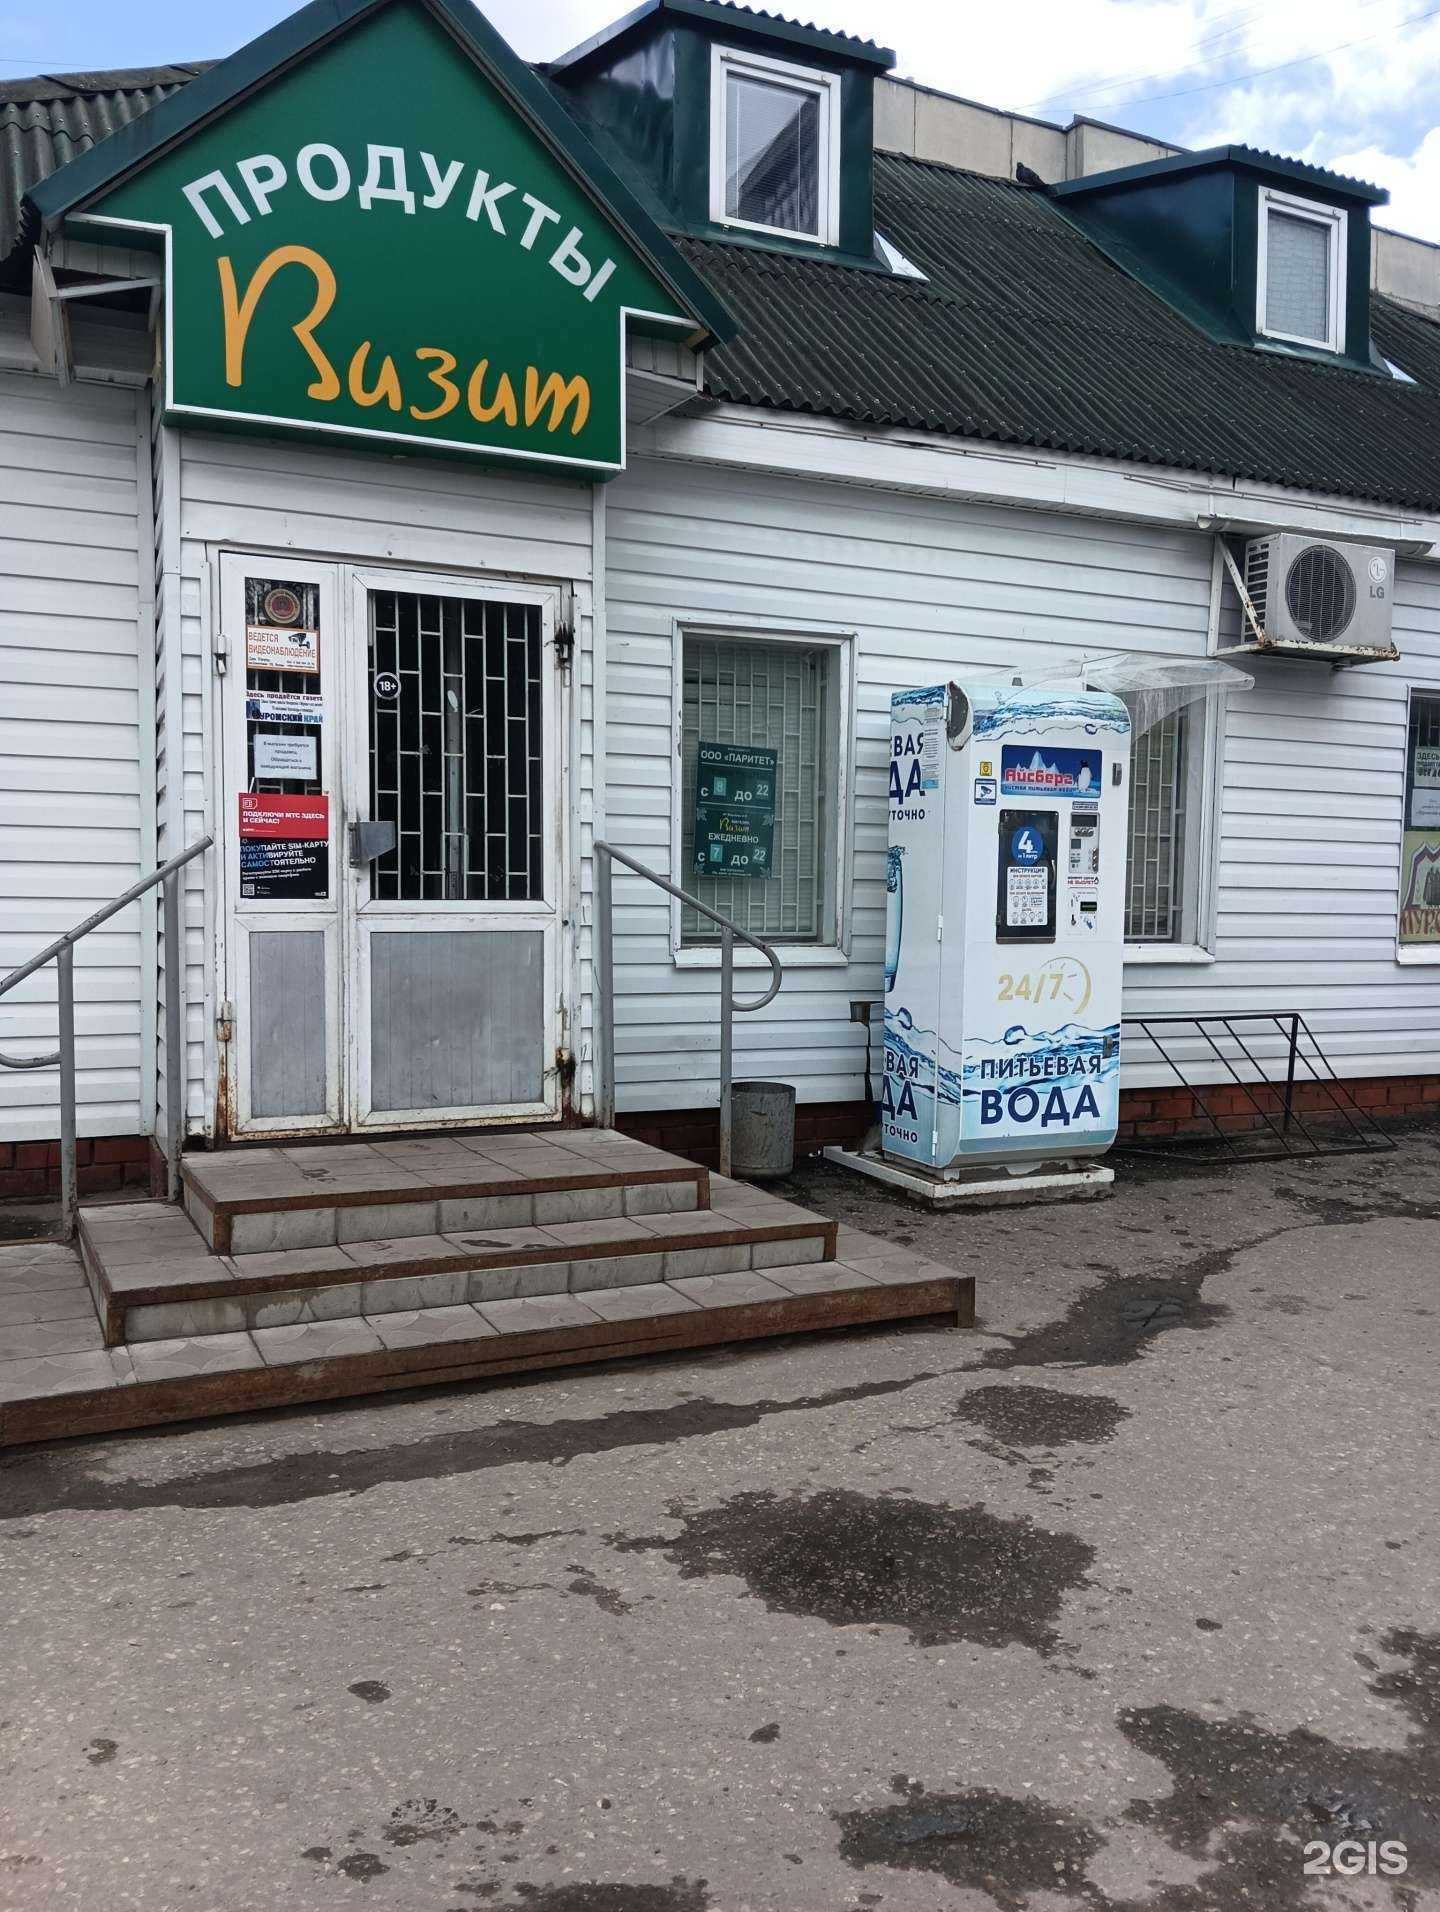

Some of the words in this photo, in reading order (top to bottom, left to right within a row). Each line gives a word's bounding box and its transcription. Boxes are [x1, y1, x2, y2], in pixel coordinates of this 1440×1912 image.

[182, 143, 617, 302] ПРОДУКТЫ
[217, 244, 590, 436] Визит
[1369, 586, 1384, 599] LG
[248, 644, 316, 658] ВИДЕОНАБЛЮДЕНИЕ
[378, 681, 397, 691] 18+
[257, 712, 303, 723] УРОМСКИЙ
[890, 732, 924, 757] ВАЯ
[701, 750, 722, 760] ООО
[724, 753, 775, 766] «ПАРИТЕТ»
[1005, 767, 1074, 786] Айсберг
[756, 784, 769, 796] 22
[708, 832, 759, 844] ЕЖЕДНЕВНО
[1018, 831, 1034, 853] 4
[240, 843, 287, 852] ПОКУПАЙТЕ
[287, 841, 329, 849] SIM-КАРТУ
[241, 856, 316, 868] САМОСТОЯТЕЛЬНО
[248, 850, 303, 860] АКТИВИРУЙТЕ
[753, 848, 766, 862] 22
[997, 973, 1064, 1004] 24/7
[884, 1051, 919, 1079] ВАЯ
[980, 1054, 1102, 1079] ПИТЬЕВАЯ
[980, 1084, 1101, 1128] ВОДА
